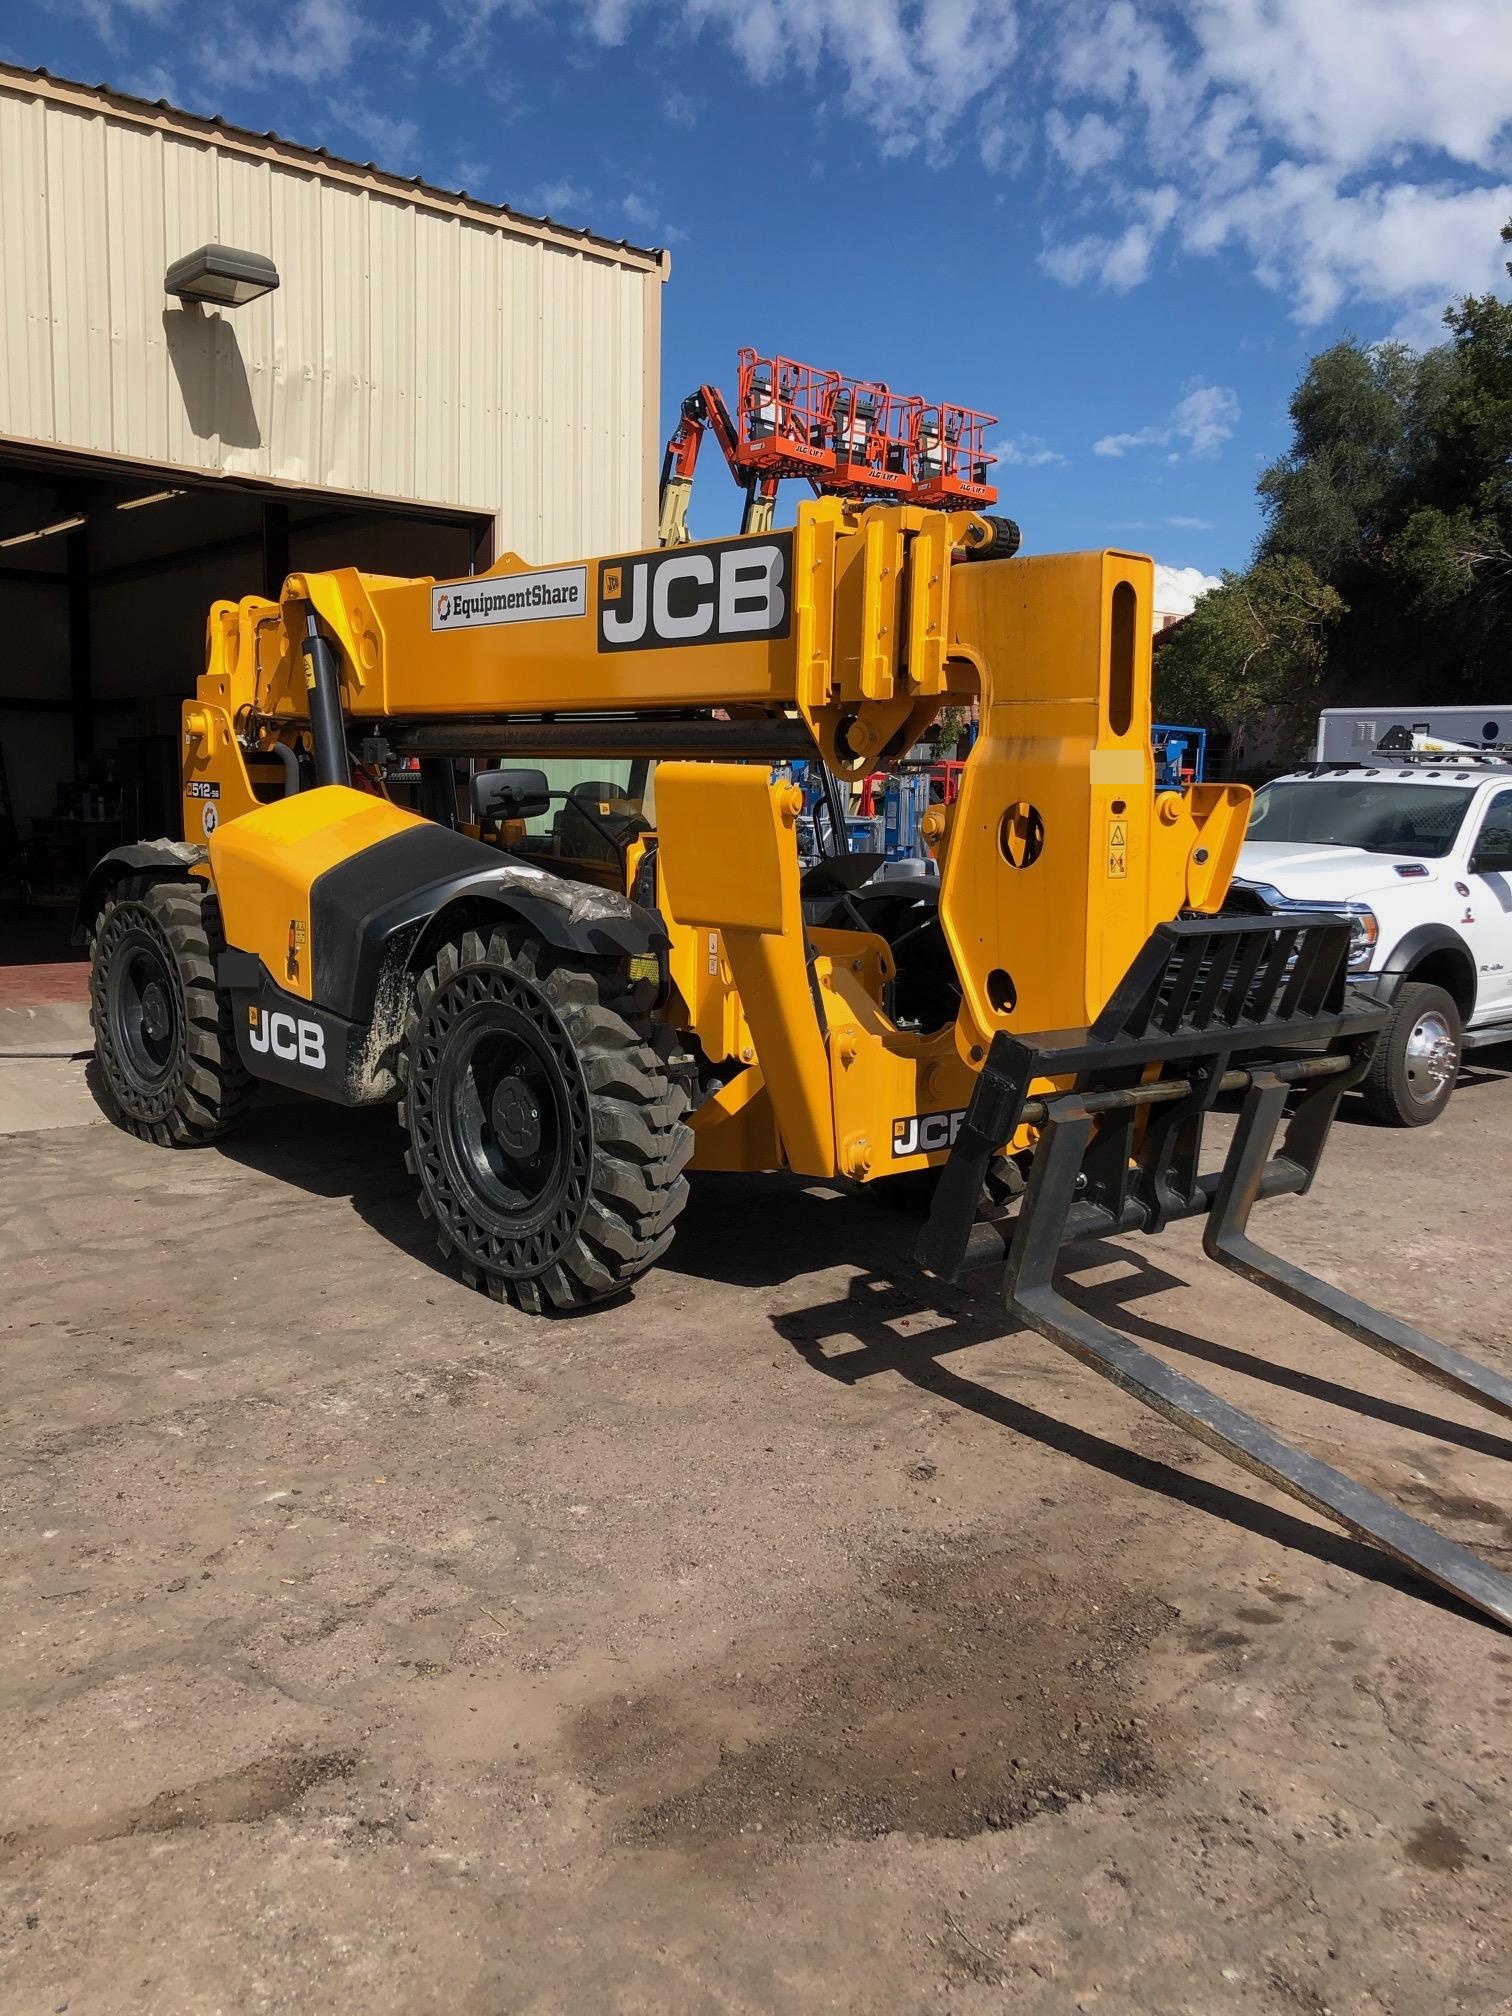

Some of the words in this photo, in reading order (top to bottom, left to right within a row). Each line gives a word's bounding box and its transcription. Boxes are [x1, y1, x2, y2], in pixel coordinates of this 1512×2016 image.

[795, 445, 808, 454] JLG
[810, 447, 824, 458] LIFT
[868, 470, 881, 479] JLG
[883, 472, 898, 482] LIFT
[960, 483, 971, 492] JLG
[972, 485, 986, 495] LIFT
[453, 584, 578, 619] EquipmentShare
[602, 545, 785, 643] JCB
[250, 1010, 326, 1069] JCB
